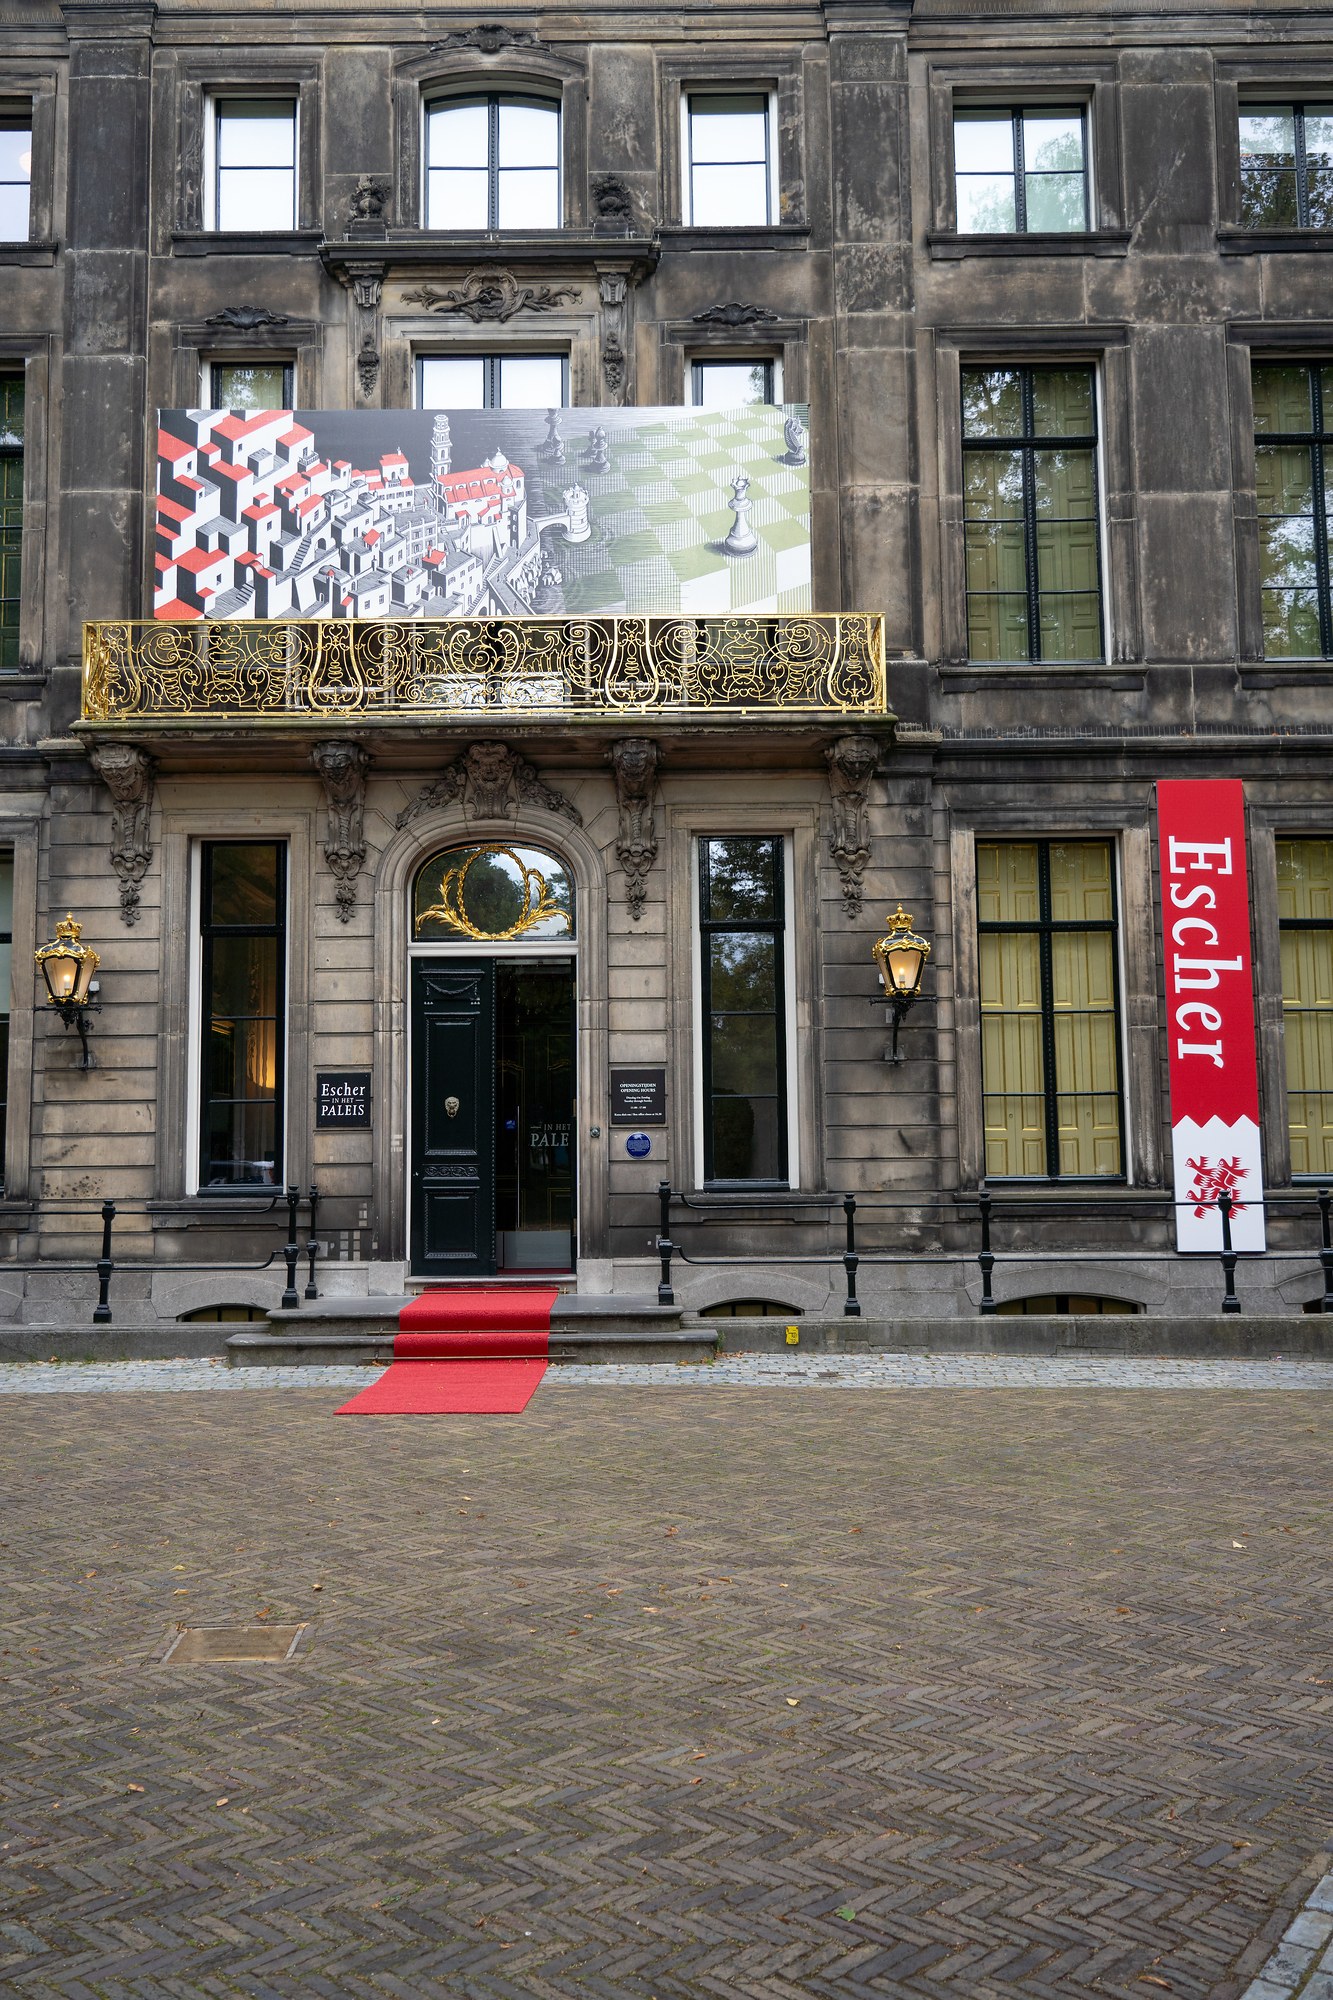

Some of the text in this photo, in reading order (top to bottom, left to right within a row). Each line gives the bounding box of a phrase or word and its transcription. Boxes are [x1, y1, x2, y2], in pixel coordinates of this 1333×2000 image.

[1168, 835, 1243, 1069] Escher
[321, 1082, 366, 1097] Escher
[321, 1104, 365, 1116] PALEIS
[543, 1123, 571, 1131] IN HET
